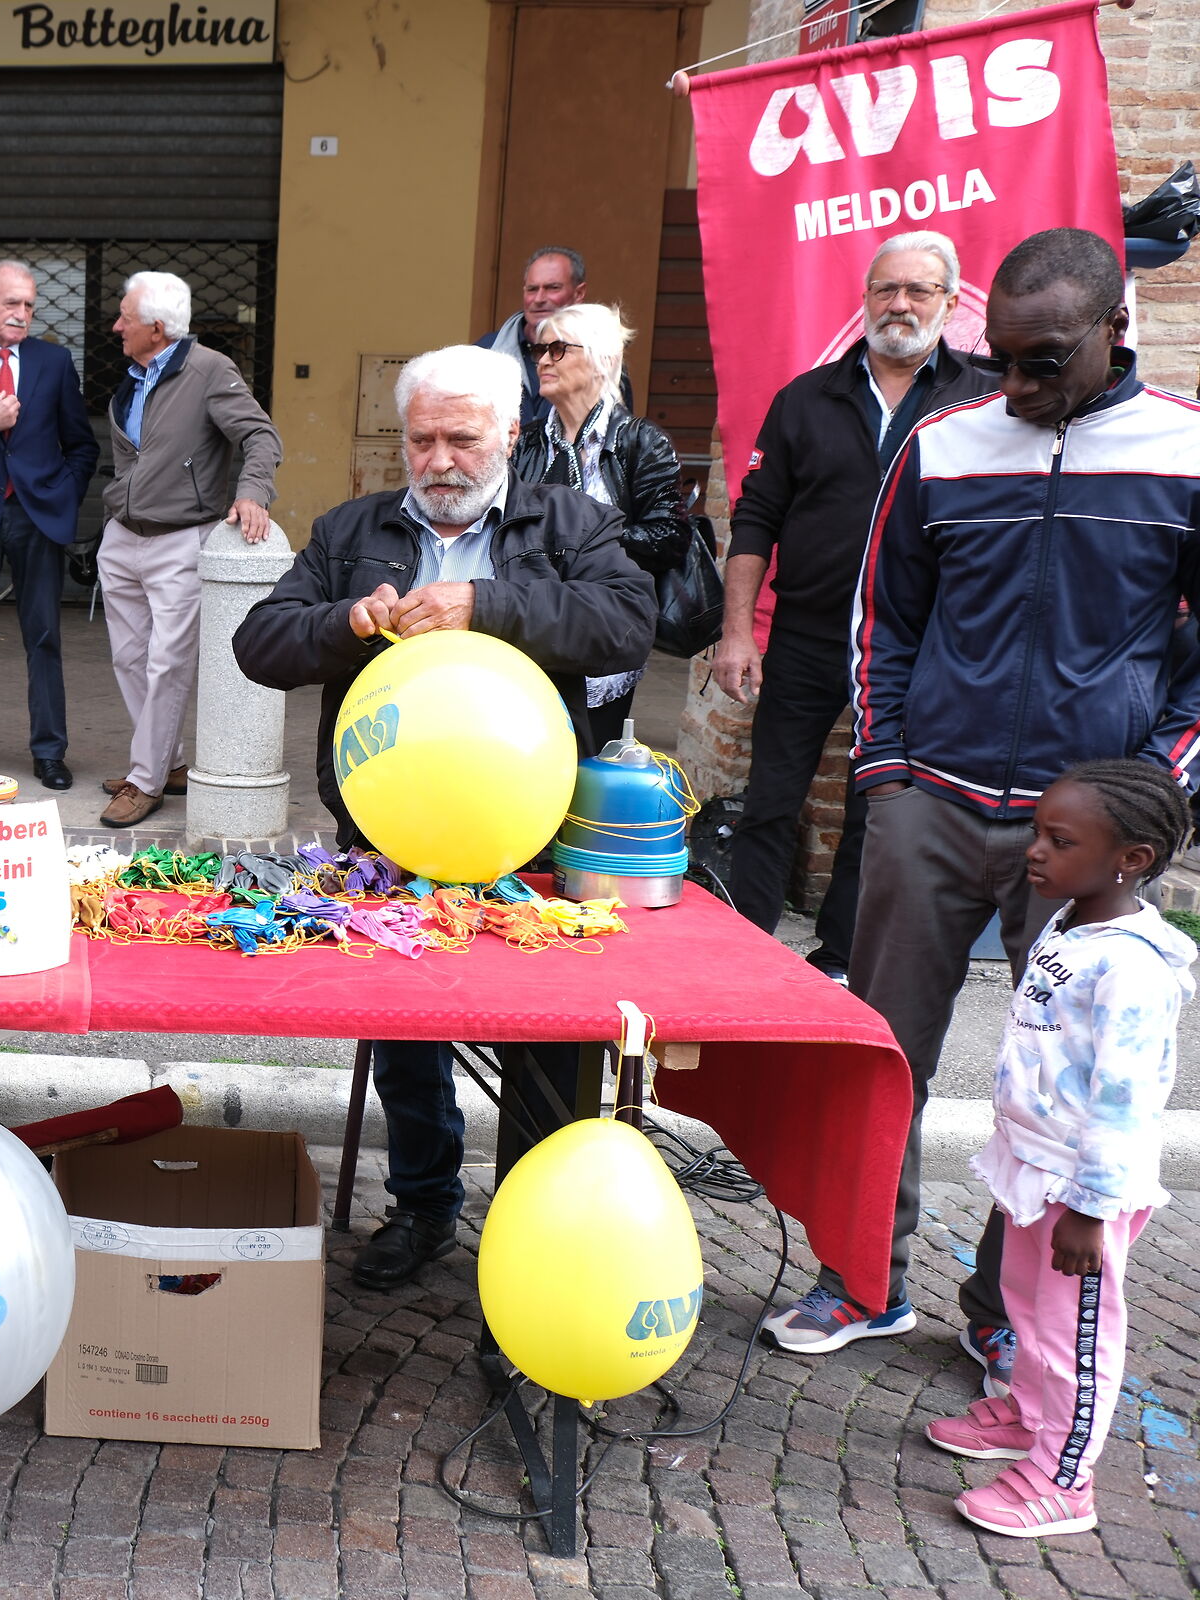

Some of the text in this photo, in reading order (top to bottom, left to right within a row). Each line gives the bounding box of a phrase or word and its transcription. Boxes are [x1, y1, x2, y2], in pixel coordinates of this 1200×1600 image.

[13, 3, 270, 56] Botteghina
[748, 38, 1060, 177] AVIS
[320, 139, 328, 152] 6
[794, 168, 997, 241] MELDOLA
[79, 1344, 108, 1357] 1547246
[89, 1408, 270, 1427] contiene 16 sacchetti da 250g
